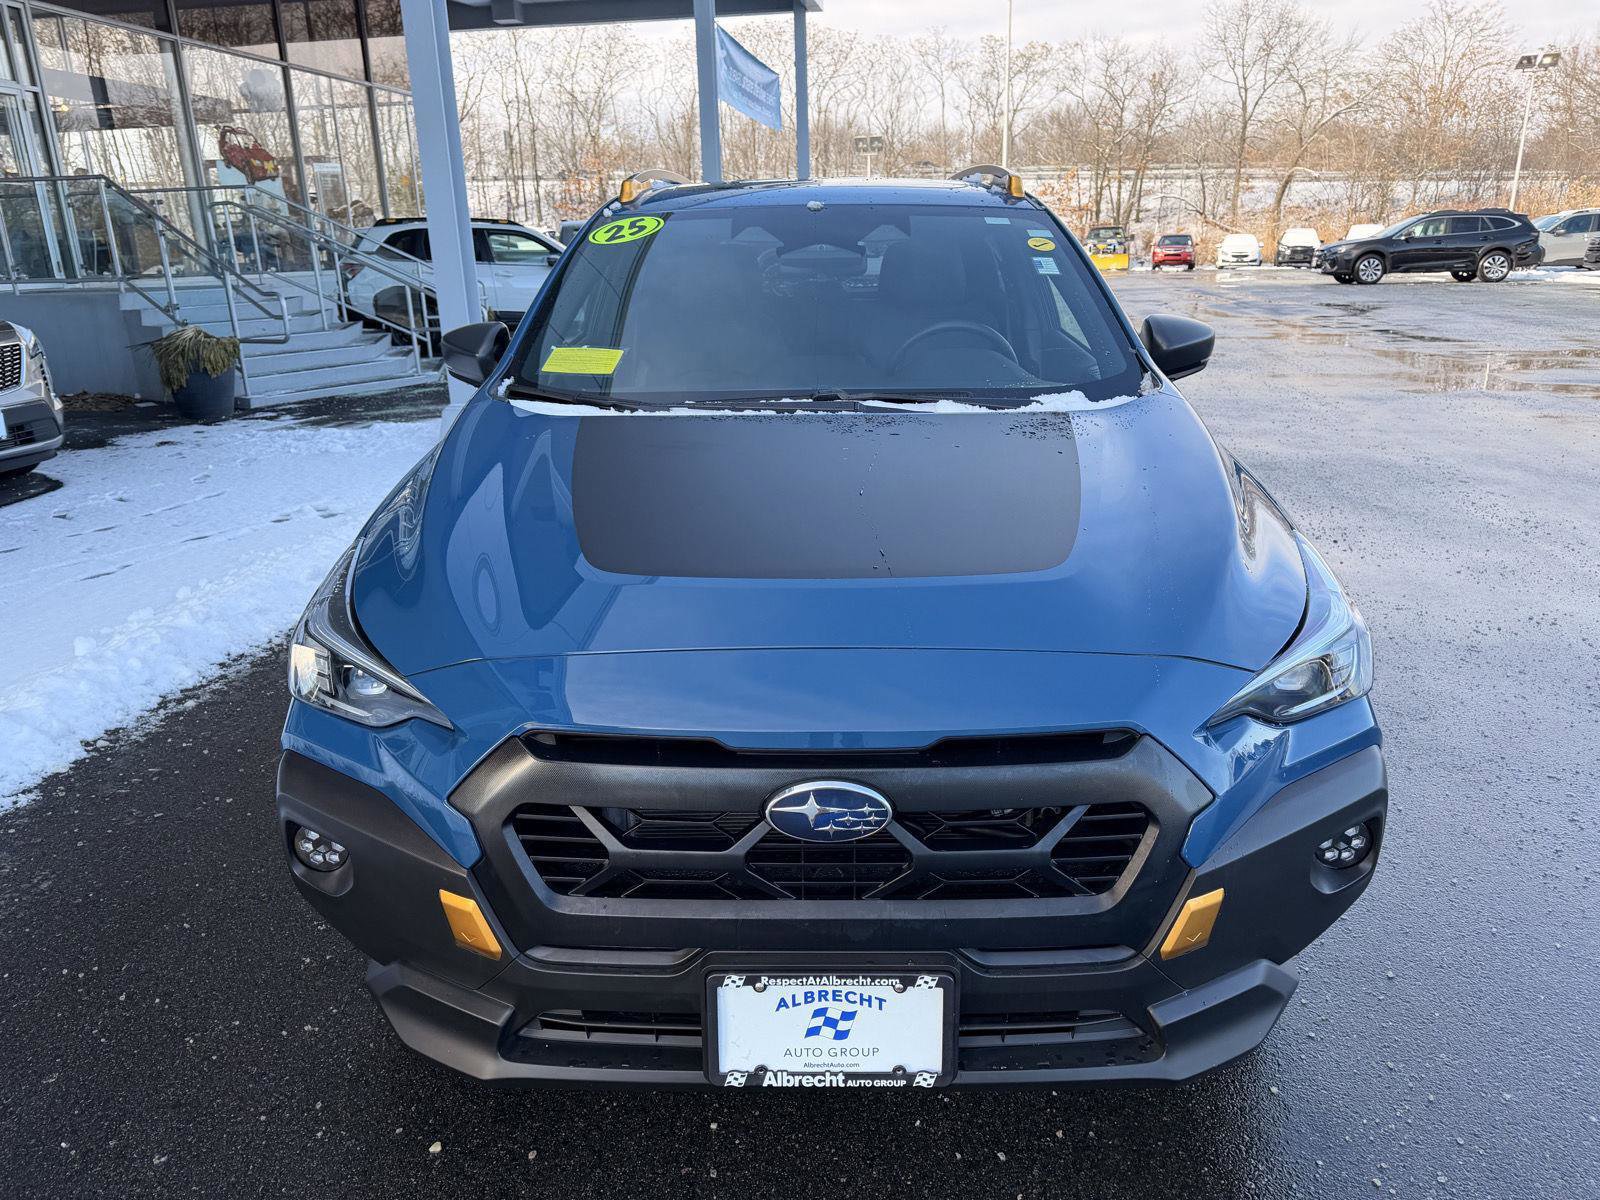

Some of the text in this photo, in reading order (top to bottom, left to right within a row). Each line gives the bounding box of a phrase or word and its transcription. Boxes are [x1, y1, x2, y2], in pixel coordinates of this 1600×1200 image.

[603, 217, 648, 243] 25
[760, 976, 901, 987] RespectAtAlbrecht.com
[775, 989, 887, 1012] ALBRECHT
[783, 1047, 880, 1058] AUTO GROUP
[762, 1071, 846, 1088] Albrecht
